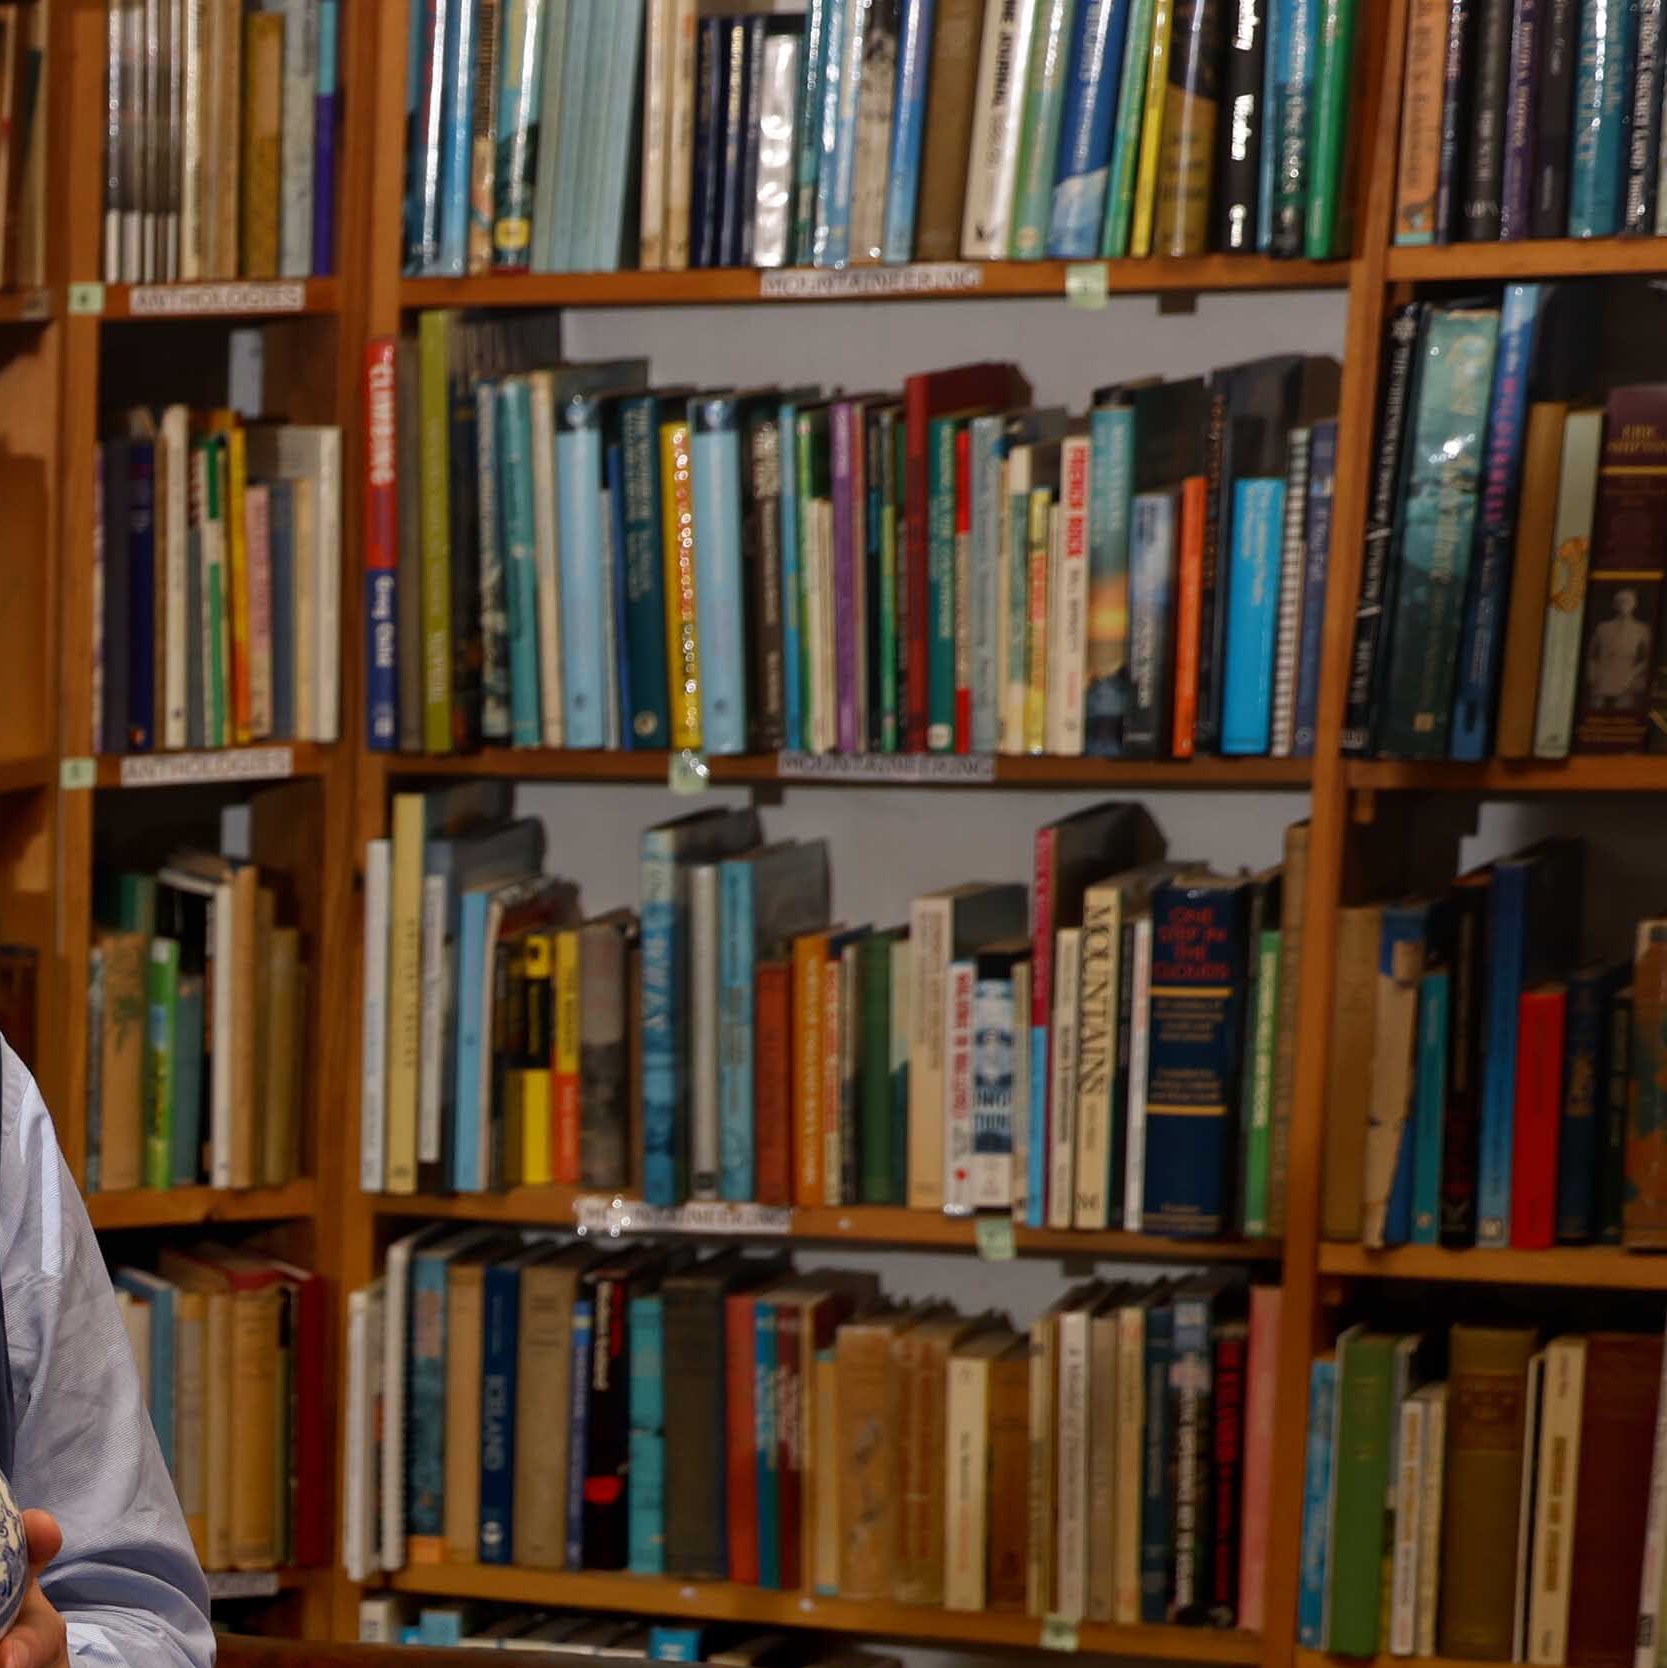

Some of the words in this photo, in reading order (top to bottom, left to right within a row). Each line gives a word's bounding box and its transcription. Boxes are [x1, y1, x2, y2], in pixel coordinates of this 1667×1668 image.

[763, 270, 979, 296] MOUNTAINEERING
[781, 756, 994, 780] MOUNTAINEERING
[1082, 903, 1111, 1096] MOUNTAINS
